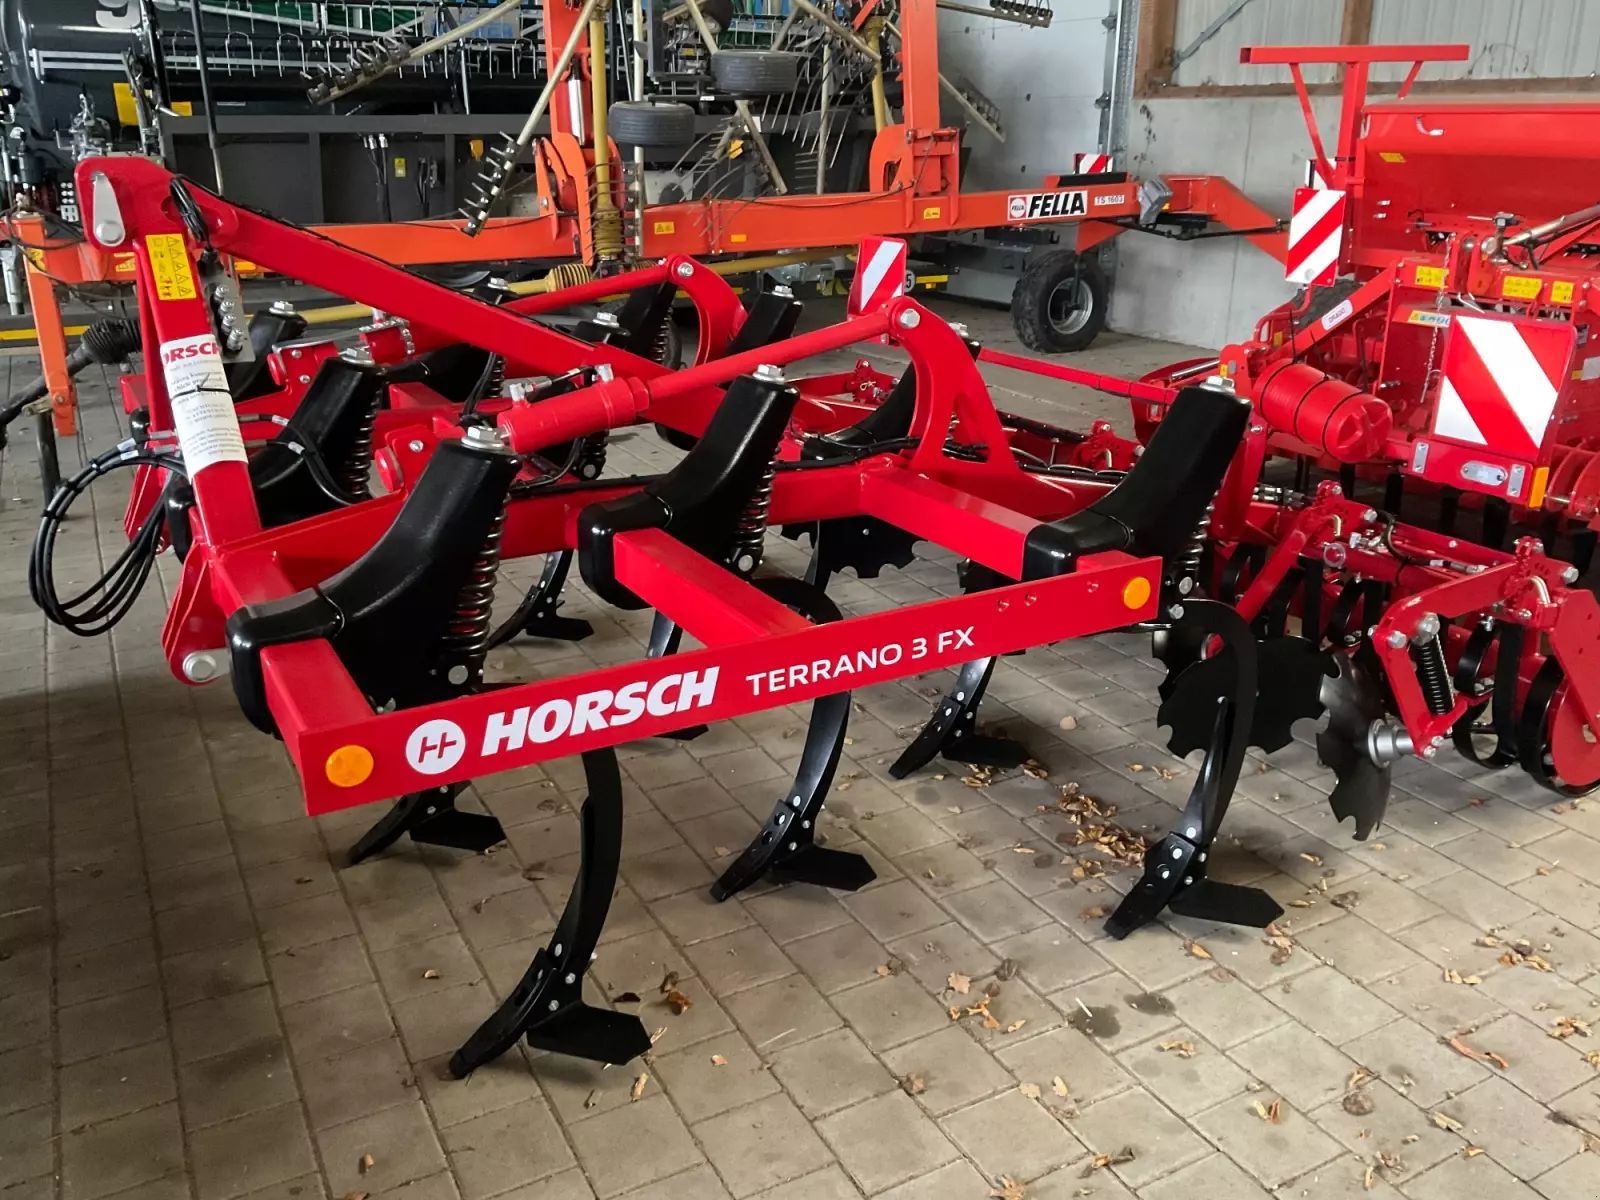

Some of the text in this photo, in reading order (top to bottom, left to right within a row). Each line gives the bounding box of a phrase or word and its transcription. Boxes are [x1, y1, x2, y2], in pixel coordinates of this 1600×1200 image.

[1028, 193, 1085, 217] FELLA
[746, 626, 974, 696] TERRANO 3 FX
[481, 666, 720, 757] HORSCH
